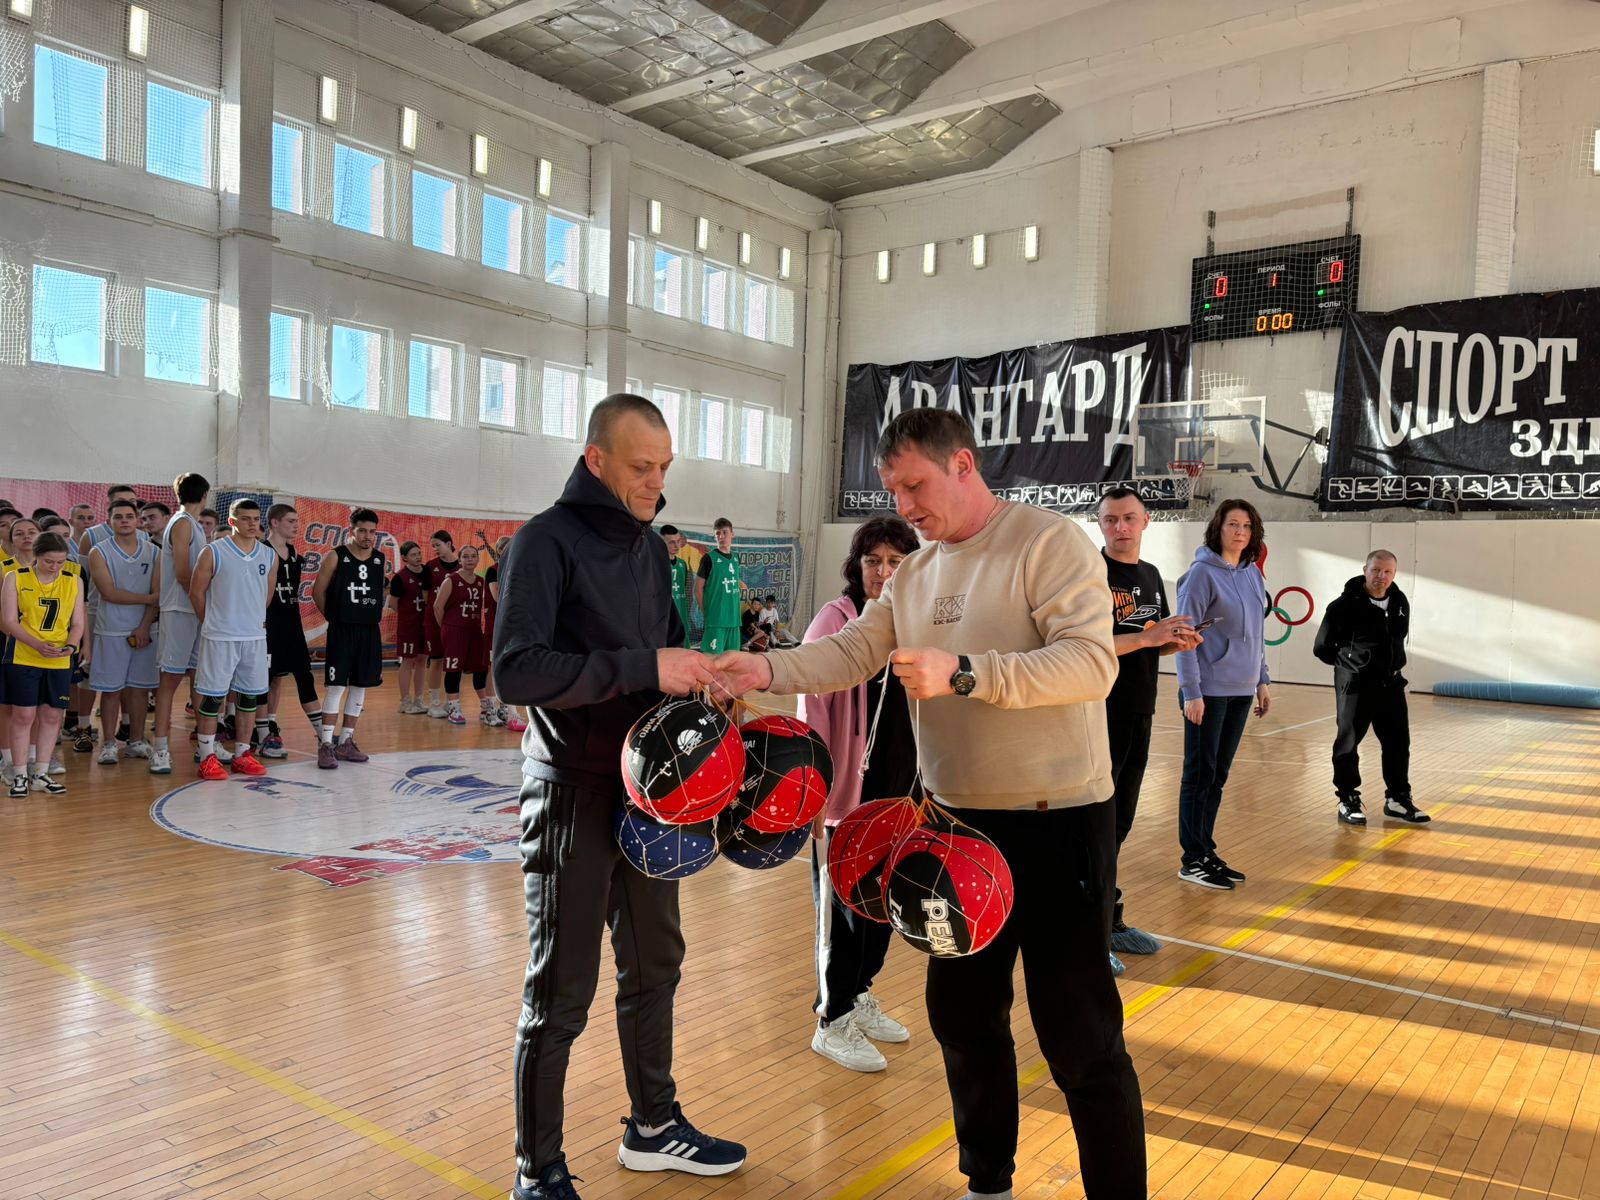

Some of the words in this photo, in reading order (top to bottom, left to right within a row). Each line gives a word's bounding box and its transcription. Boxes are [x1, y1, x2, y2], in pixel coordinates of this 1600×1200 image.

[1320, 255, 1340, 263] СЧЕТ
[1258, 264, 1286, 273] ПЕРИОД
[1329, 262, 1342, 282] 0
[1271, 273, 1277, 287] 1
[1215, 277, 1228, 297] 0
[1258, 307, 1281, 315] ВРЕМЯ
[1379, 326, 1578, 447] СПОРТ
[304, 522, 390, 549] СПТ
[739, 551, 792, 567] ДОРОВОМ
[141, 563, 149, 574] 7
[258, 564, 266, 576] 8
[358, 564, 368, 580] 8
[728, 563, 735, 575] 4
[466, 587, 480, 600] 12
[740, 584, 791, 602] ДОРОВЫЙ
[38, 597, 60, 631] 7
[403, 643, 414, 654] 11
[710, 639, 717, 650] 4
[446, 657, 459, 669] 12
[329, 666, 336, 681] 8
